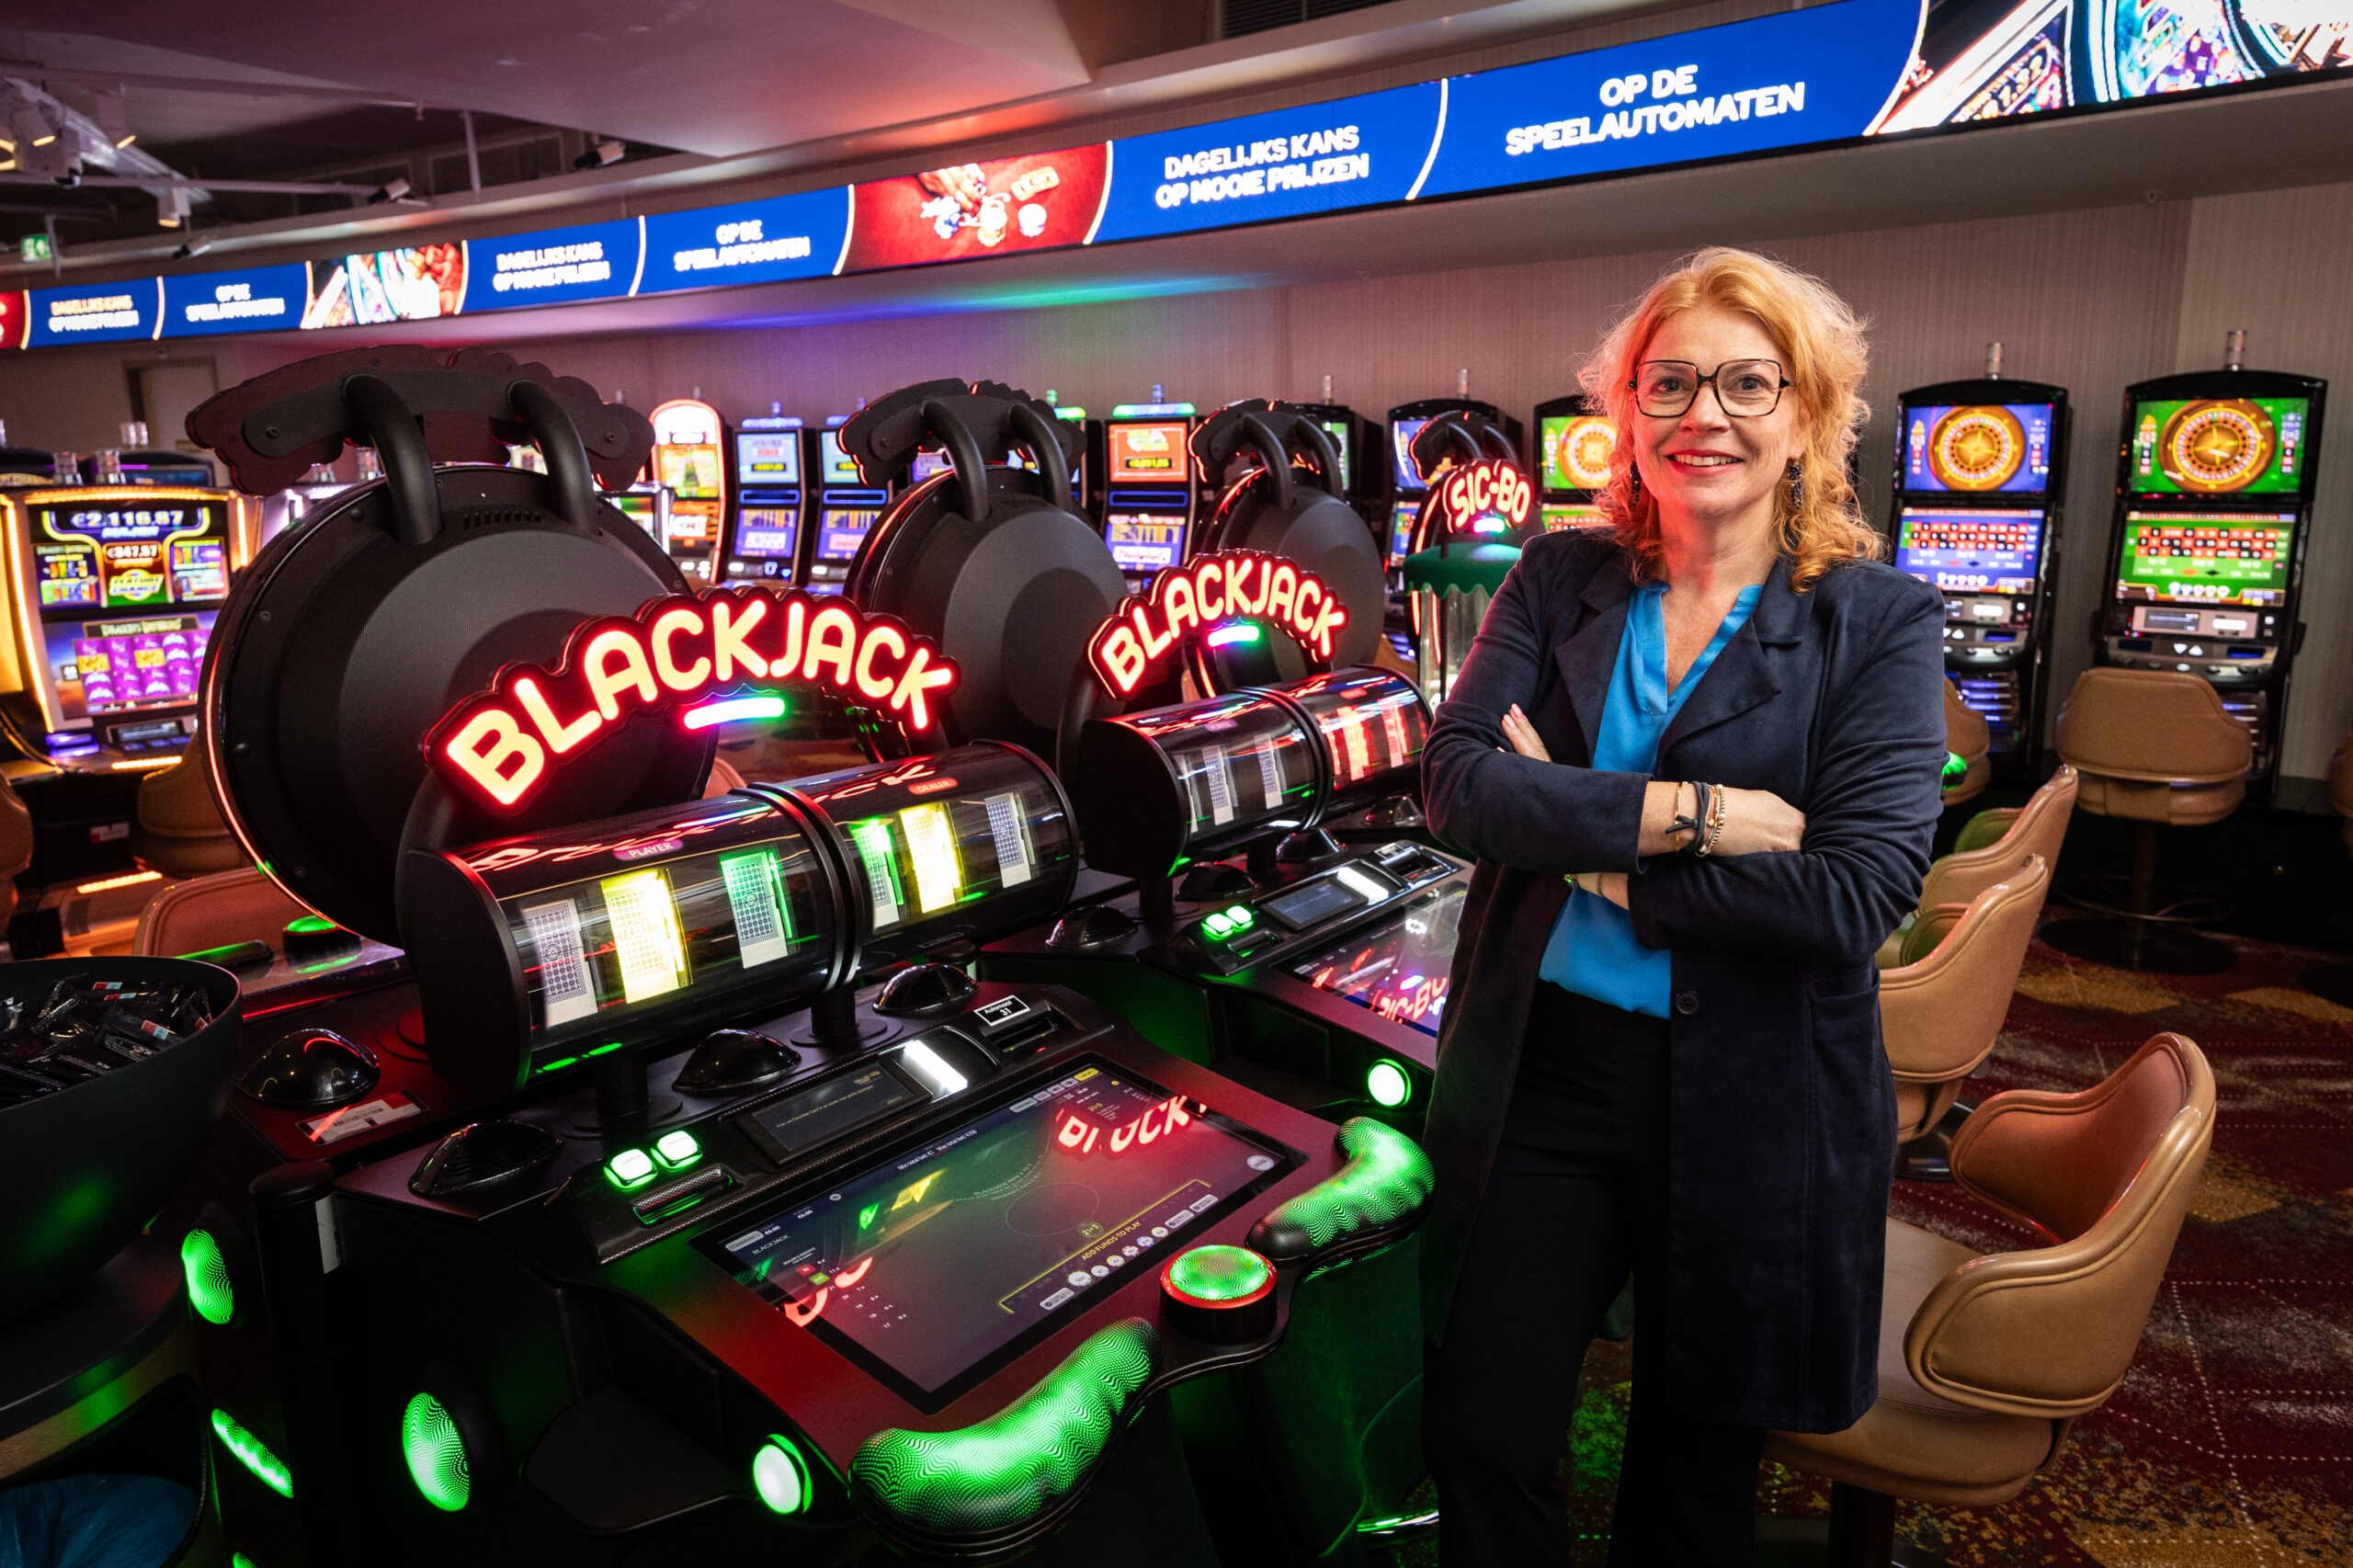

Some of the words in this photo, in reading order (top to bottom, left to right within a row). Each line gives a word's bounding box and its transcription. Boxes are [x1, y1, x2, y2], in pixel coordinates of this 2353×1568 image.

[1599, 74, 1647, 107] OP
[1653, 64, 1698, 98] DE
[1506, 82, 1805, 155] SPEELAUTOMATEN
[1165, 139, 1288, 180] DAGELIJKS
[1291, 126, 1359, 158] KANS
[1155, 182, 1188, 209] OP
[1190, 169, 1265, 204] MOOIE
[1267, 153, 1370, 192] PRIJZEN
[1450, 466, 1530, 528] SIC-BO
[1101, 558, 1346, 692] BLACKJACK
[446, 598, 953, 806] BLACKJACK
[916, 780, 951, 791] DEALER
[628, 842, 674, 858] PLAYER
[999, 1007, 1012, 1016] 31
[1081, 1223, 1100, 1236] 21+3
[1081, 1248, 1097, 1261] ADD
[1097, 1235, 1119, 1252] FUNDS
[1116, 1230, 1127, 1239] TO
[1125, 1221, 1142, 1233] PLAY
